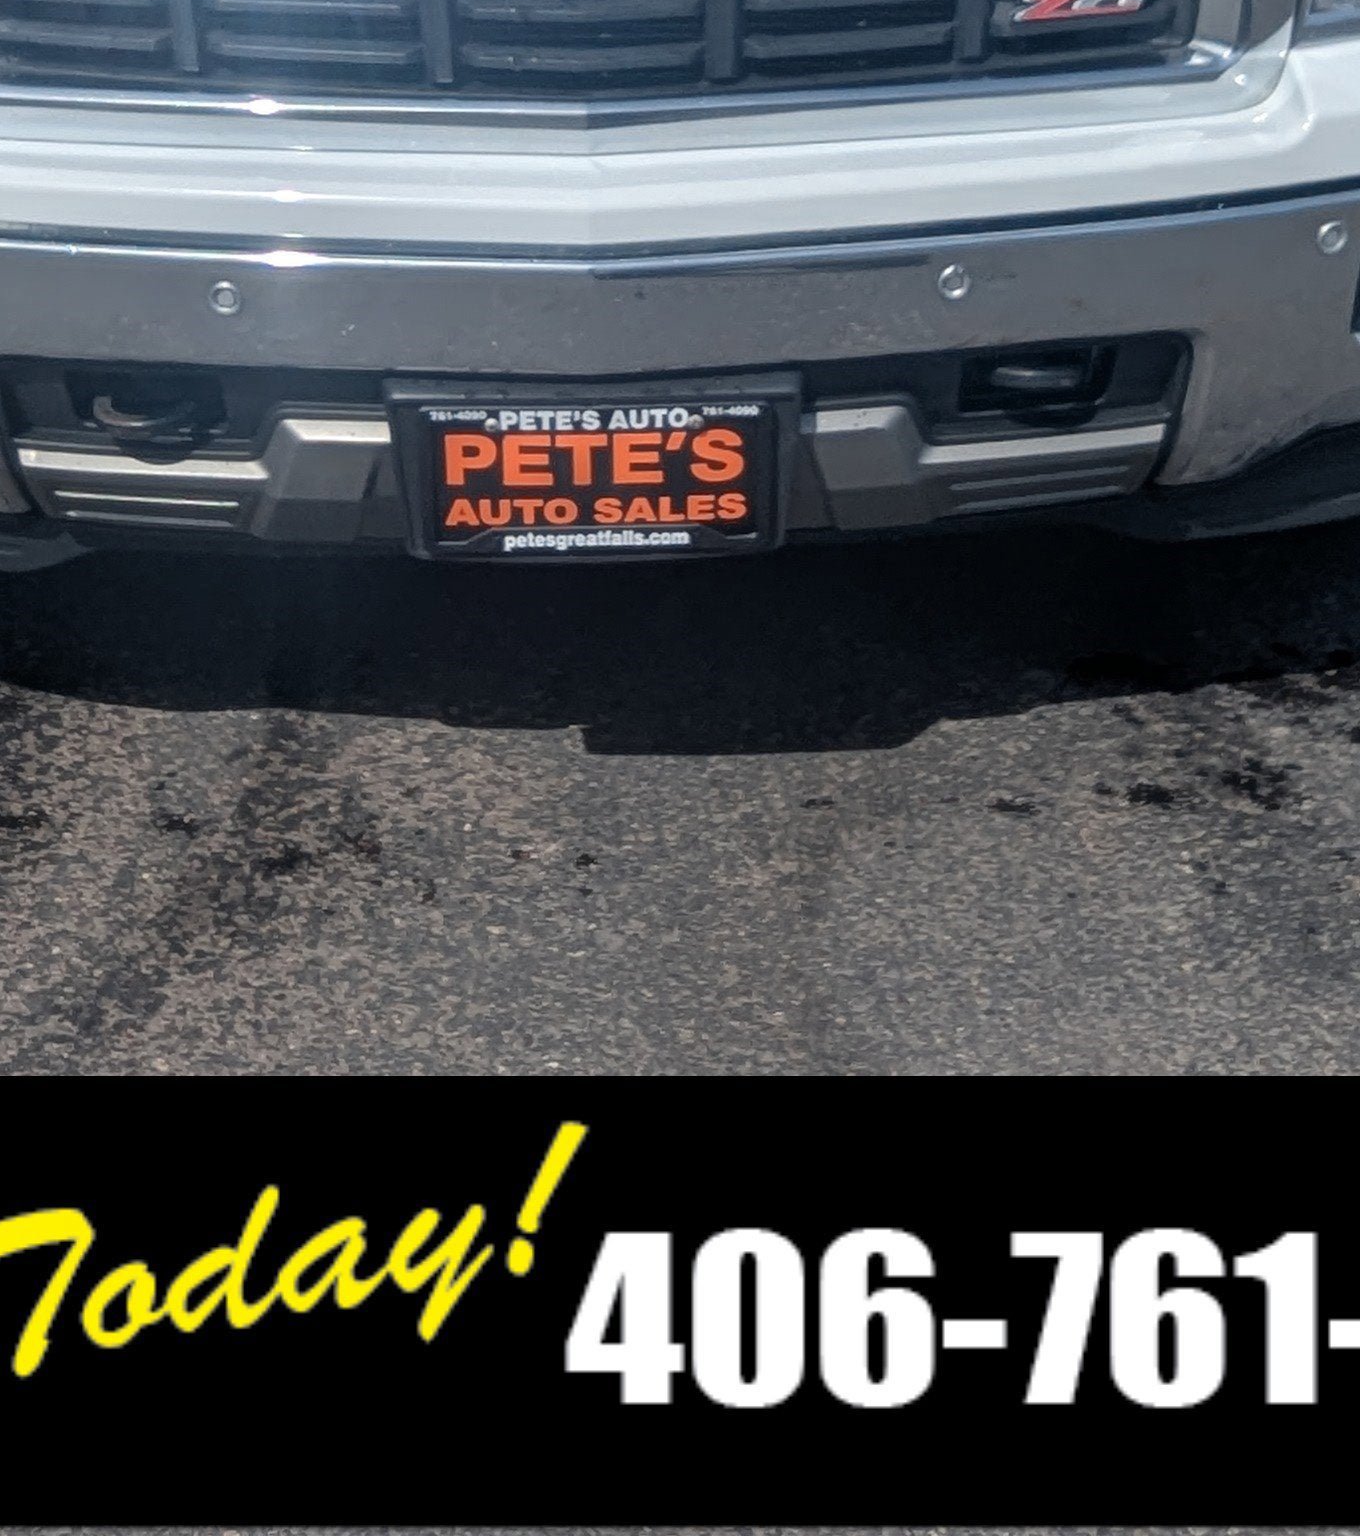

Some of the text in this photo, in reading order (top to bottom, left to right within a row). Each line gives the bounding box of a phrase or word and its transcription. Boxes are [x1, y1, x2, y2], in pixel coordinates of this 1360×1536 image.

[498, 410, 601, 431] PETE'S
[608, 407, 690, 430] AUTO
[444, 429, 745, 486] PETE'S
[444, 494, 747, 526] AUTO SALES
[503, 529, 691, 551] petesgreatfalls.com
